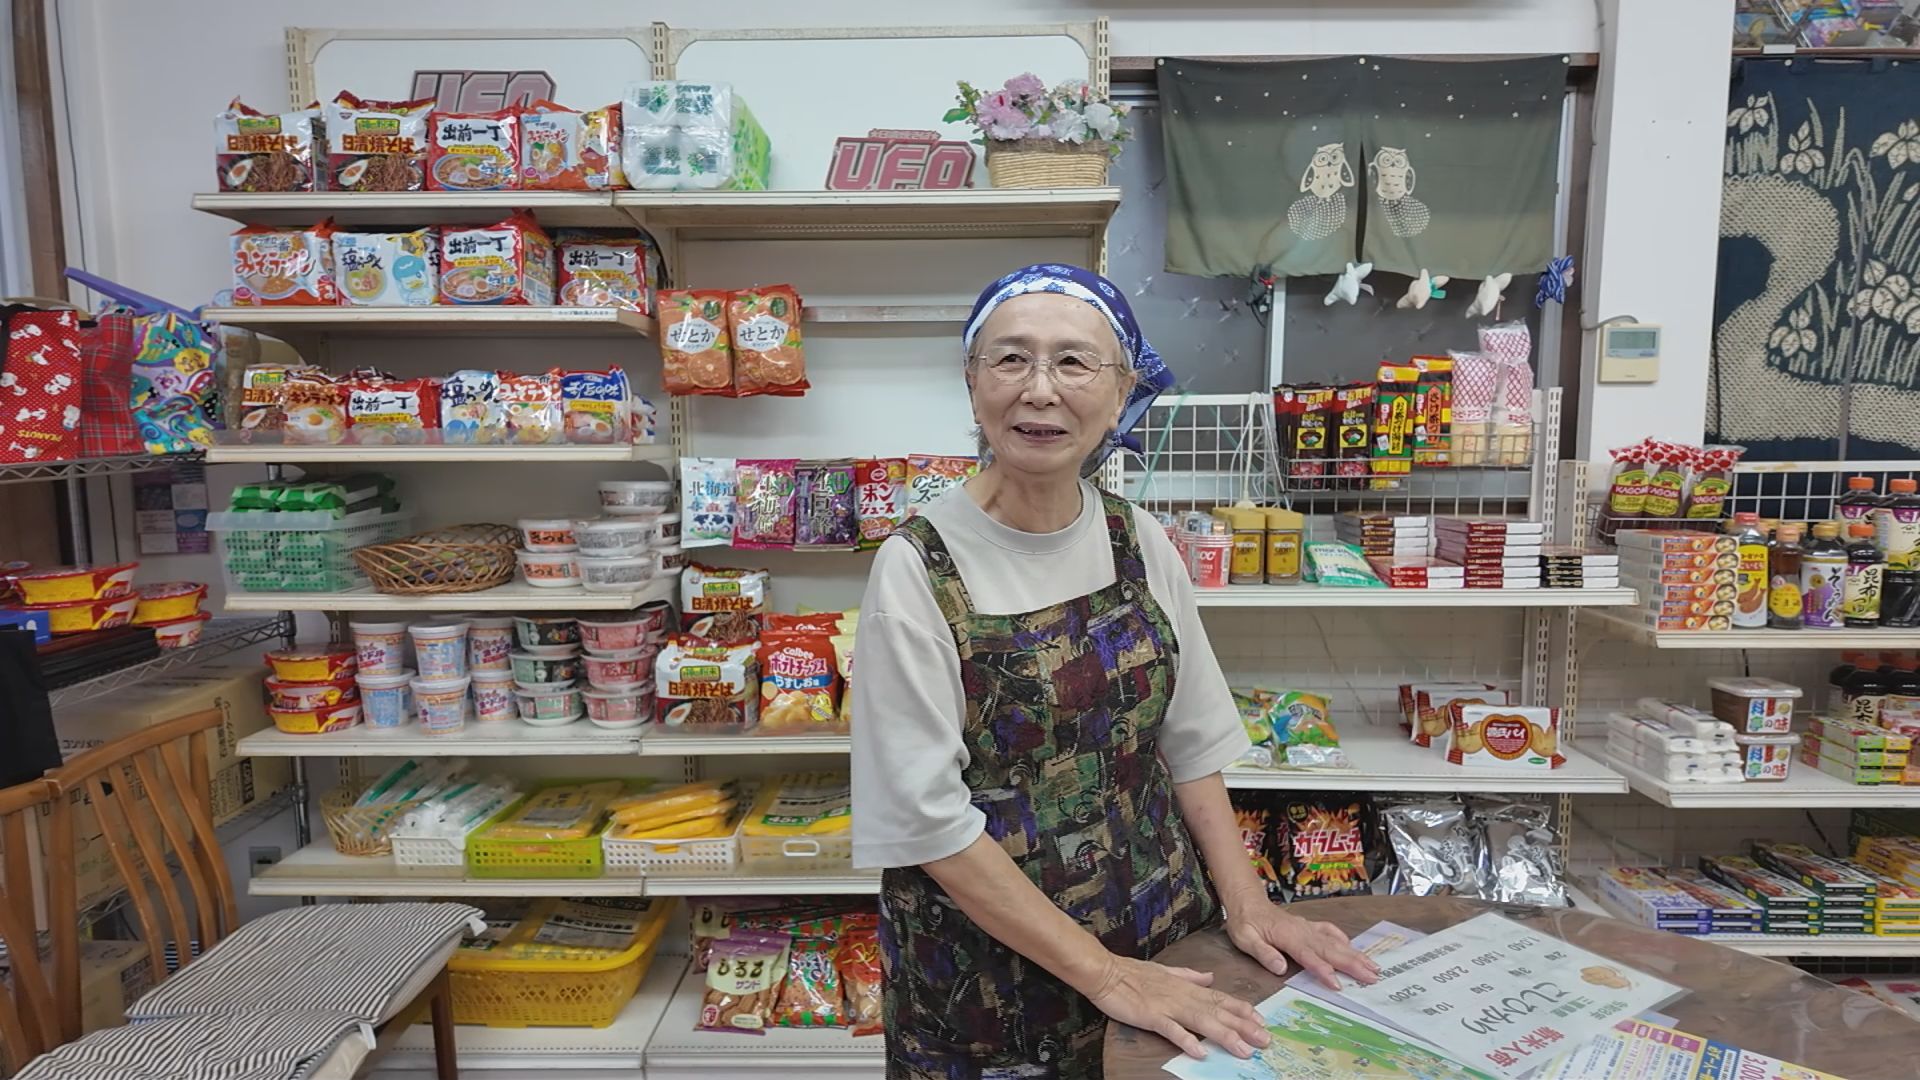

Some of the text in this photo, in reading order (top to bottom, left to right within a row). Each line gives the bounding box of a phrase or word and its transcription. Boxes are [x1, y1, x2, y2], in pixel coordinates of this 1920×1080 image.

[441, 124, 503, 142] 出前一丁
[342, 135, 415, 153] 日清焼そば
[448, 235, 508, 254] 出前一丁
[234, 249, 316, 278] みそラーメン
[568, 250, 627, 267] 出前一丁
[670, 328, 715, 343] せとか
[739, 326, 785, 341] せとか
[352, 396, 413, 411] 出前一丁
[16, 429, 63, 442] PEANUTS
[689, 480, 737, 497] 北海道
[1616, 486, 1649, 495] KAGOM
[1649, 486, 1680, 498] AGOM
[1199, 550, 1217, 561] CC
[1856, 568, 1881, 614] 昆布つゆ
[692, 597, 753, 610] 日清焼そば
[669, 682, 735, 696] 日清焼そば
[775, 676, 820, 688] うすしお味
[1294, 824, 1363, 857] カラムーチ
[1429, 965, 1471, 983] 2,600
[1385, 983, 1428, 1002] 5,200
[1461, 981, 1571, 1035] こしひかり
[1484, 1026, 1567, 1067] 新米入荷
